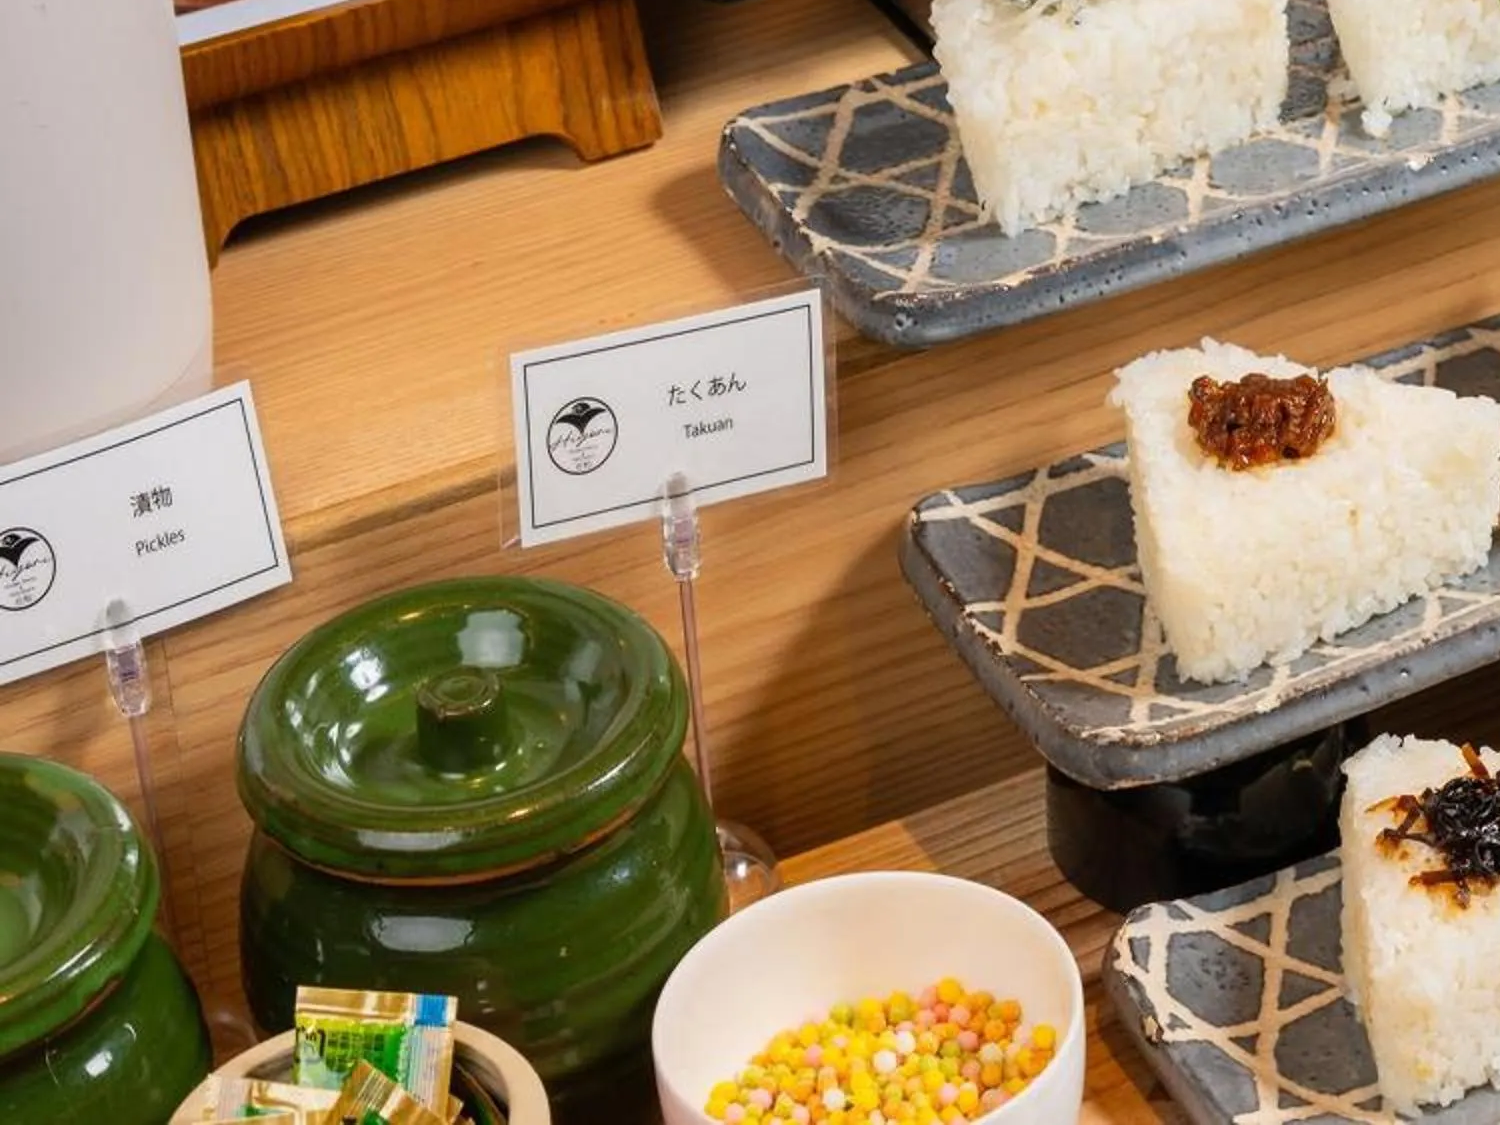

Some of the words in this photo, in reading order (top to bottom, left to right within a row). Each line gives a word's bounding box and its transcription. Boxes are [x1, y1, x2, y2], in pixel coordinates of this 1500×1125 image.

[667, 373, 747, 406] たくあん
[683, 417, 734, 439] Takuan
[129, 486, 173, 518] 漬物
[135, 528, 185, 556] Pickles
